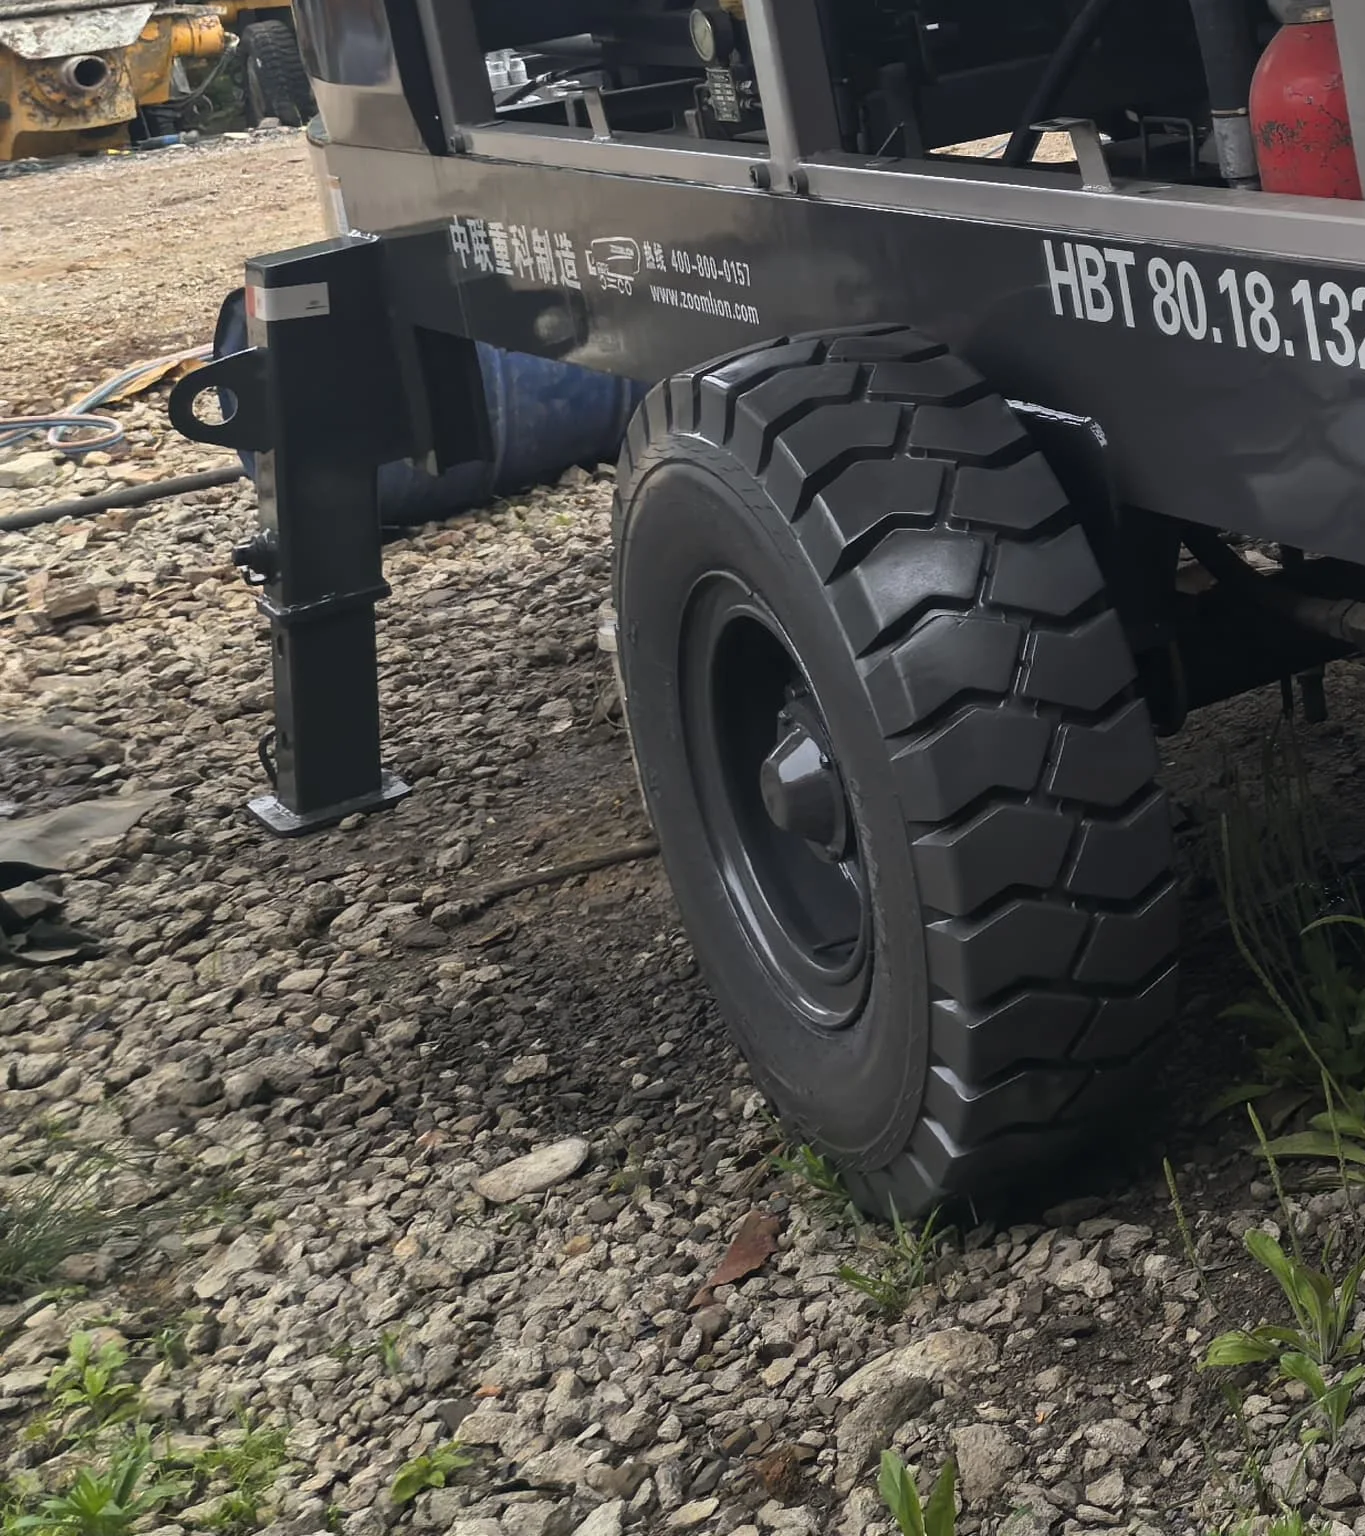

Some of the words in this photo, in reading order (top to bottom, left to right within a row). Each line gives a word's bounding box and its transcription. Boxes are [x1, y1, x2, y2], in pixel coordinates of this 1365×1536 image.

[671, 249, 751, 287] 400-800-0157
[1043, 239, 1136, 328] HBT
[650, 284, 760, 325] www.zoomlion.com
